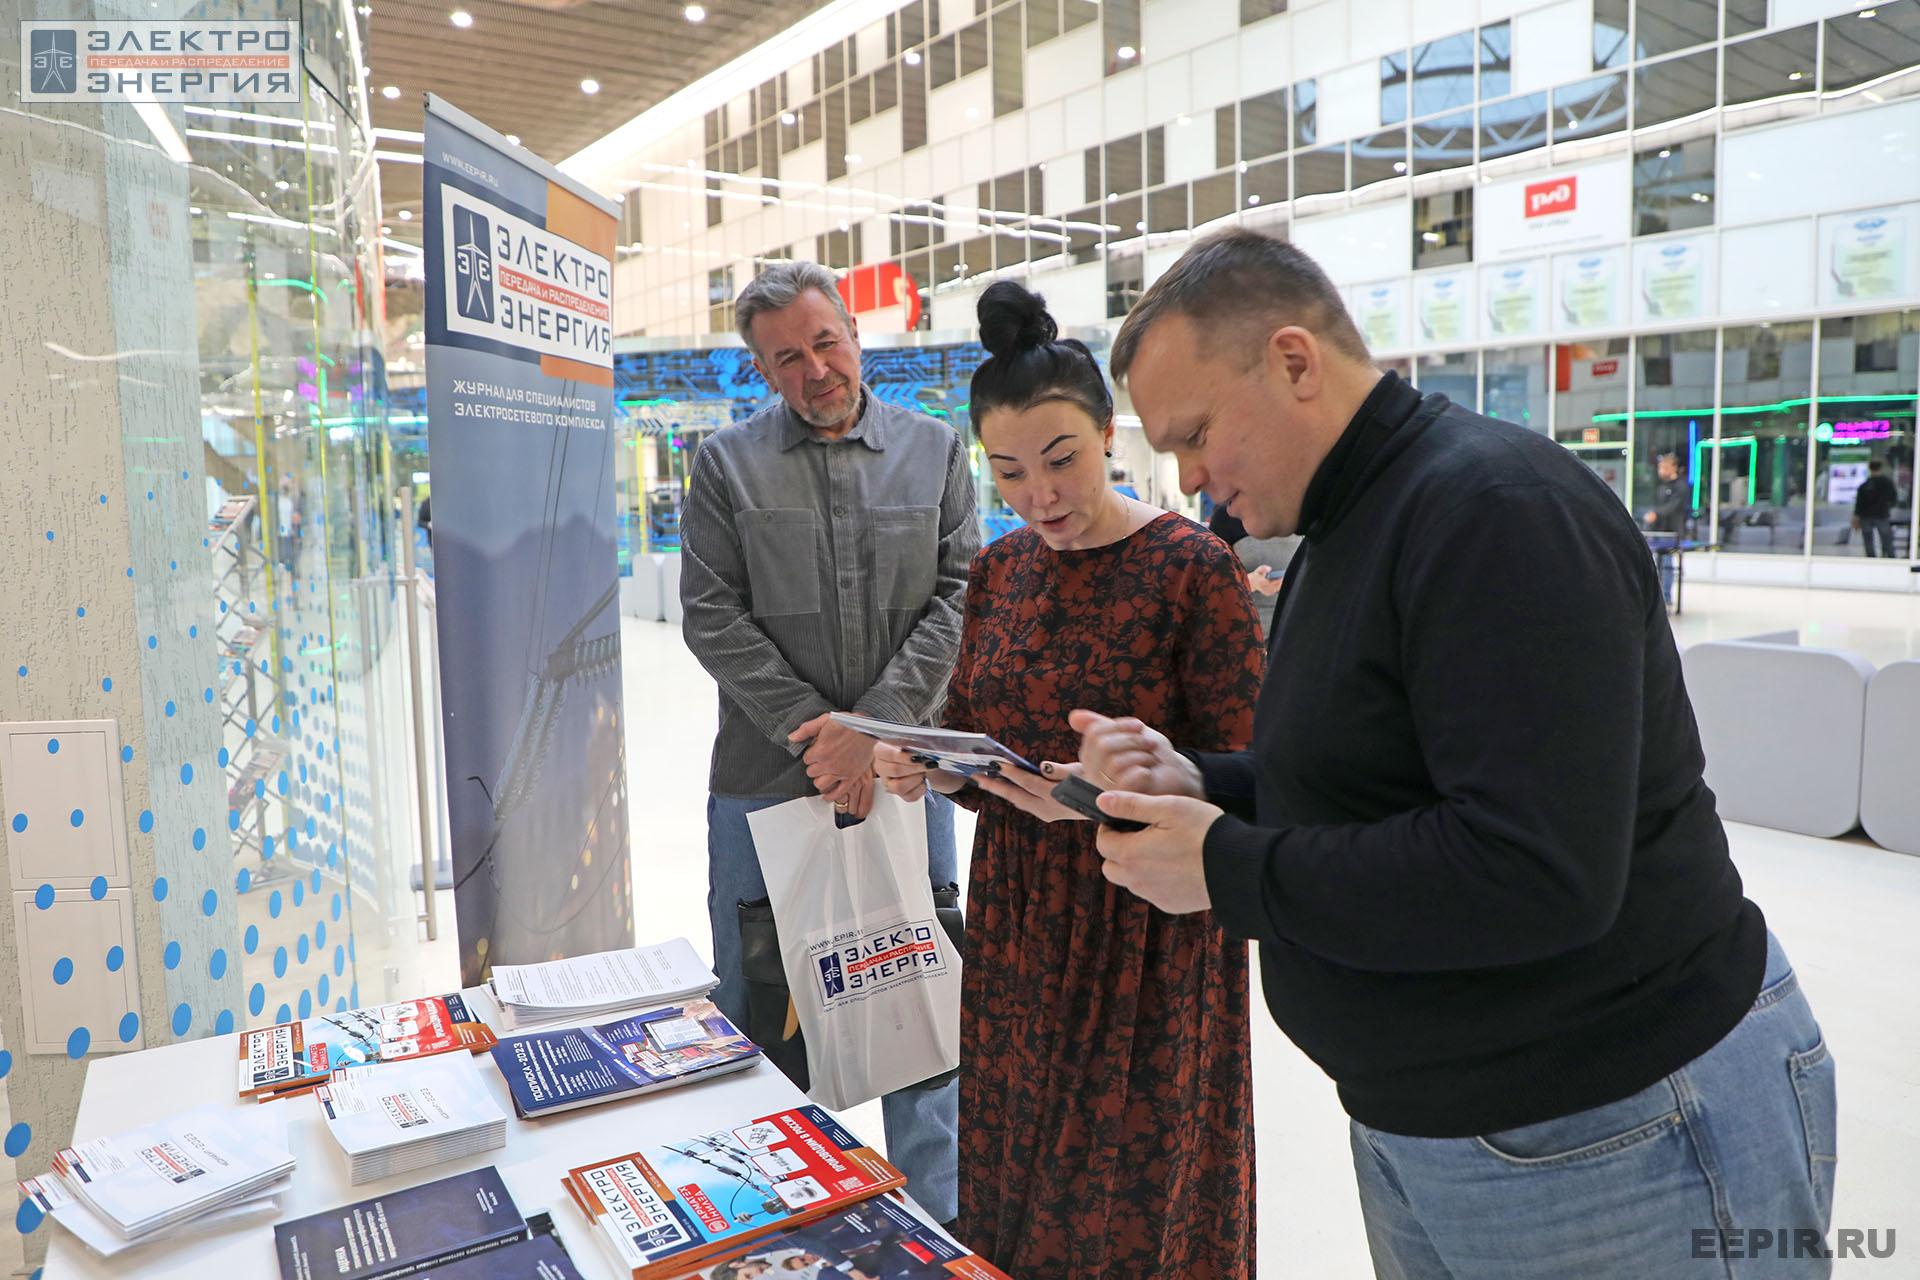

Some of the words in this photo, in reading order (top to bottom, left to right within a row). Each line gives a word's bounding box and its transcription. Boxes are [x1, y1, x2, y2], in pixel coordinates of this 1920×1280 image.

[497, 224, 609, 298] ЭЛЕКТРО
[499, 271, 542, 297] ПЕРЕДАЧА
[549, 289, 609, 321] РАСПРЕДЕЛЕНИЕ
[500, 294, 611, 354] ЭНЕРГИЯ
[453, 379, 505, 399] ЖУРНАЛ
[506, 388, 524, 401] ДЛЯ
[525, 391, 597, 412] СПЕЦИАЛИСТОВ
[454, 402, 553, 425] ЭЛЕКТРОСЕТЕВОГО
[555, 413, 606, 430] КОМПЛЕКСА
[849, 951, 939, 989] ЭНЕРГЯ
[780, 1114, 804, 1135] РОССИИ
[804, 1137, 847, 1173] ПРОИЗВОДИМ
[590, 1170, 642, 1233] ЭЛЕКТРО
[615, 1163, 669, 1224] ЭНЕРГИЯ
[678, 1186, 710, 1220] АРМАТЕХ
[695, 1190, 720, 1217] НИЛЕД
